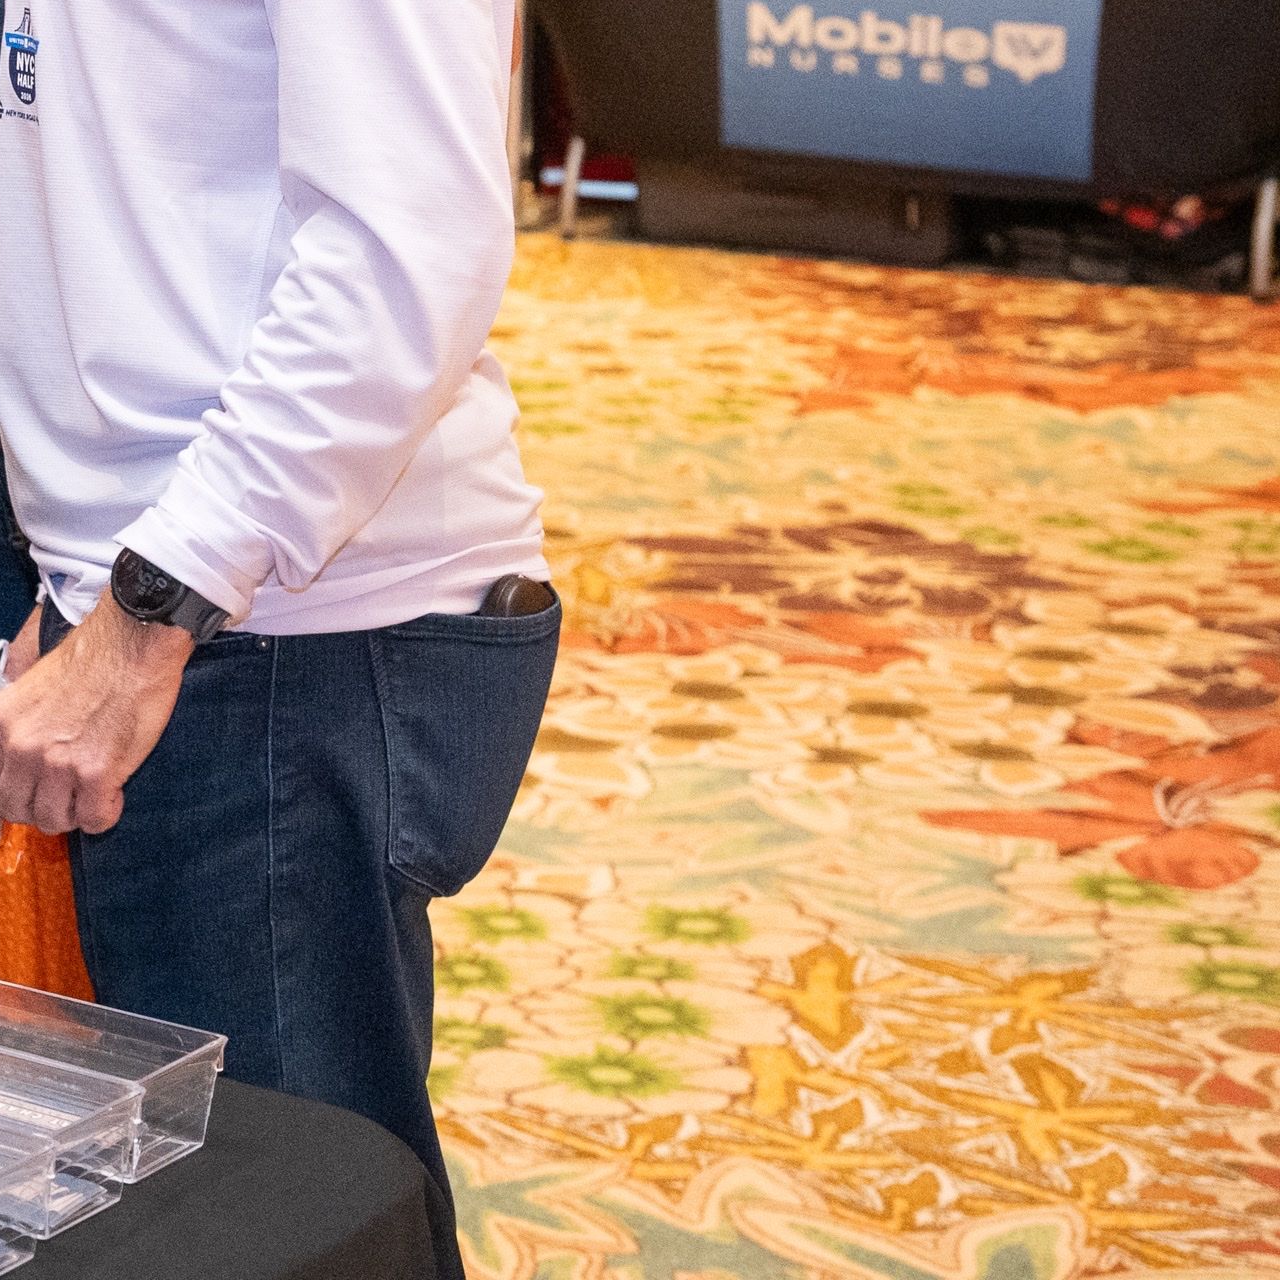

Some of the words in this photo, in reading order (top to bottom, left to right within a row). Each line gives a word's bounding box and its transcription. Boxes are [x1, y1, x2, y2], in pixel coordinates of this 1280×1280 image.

[745, 0, 991, 62] Mobile
[16, 51, 35, 75] NYC
[17, 73, 34, 90] HALF
